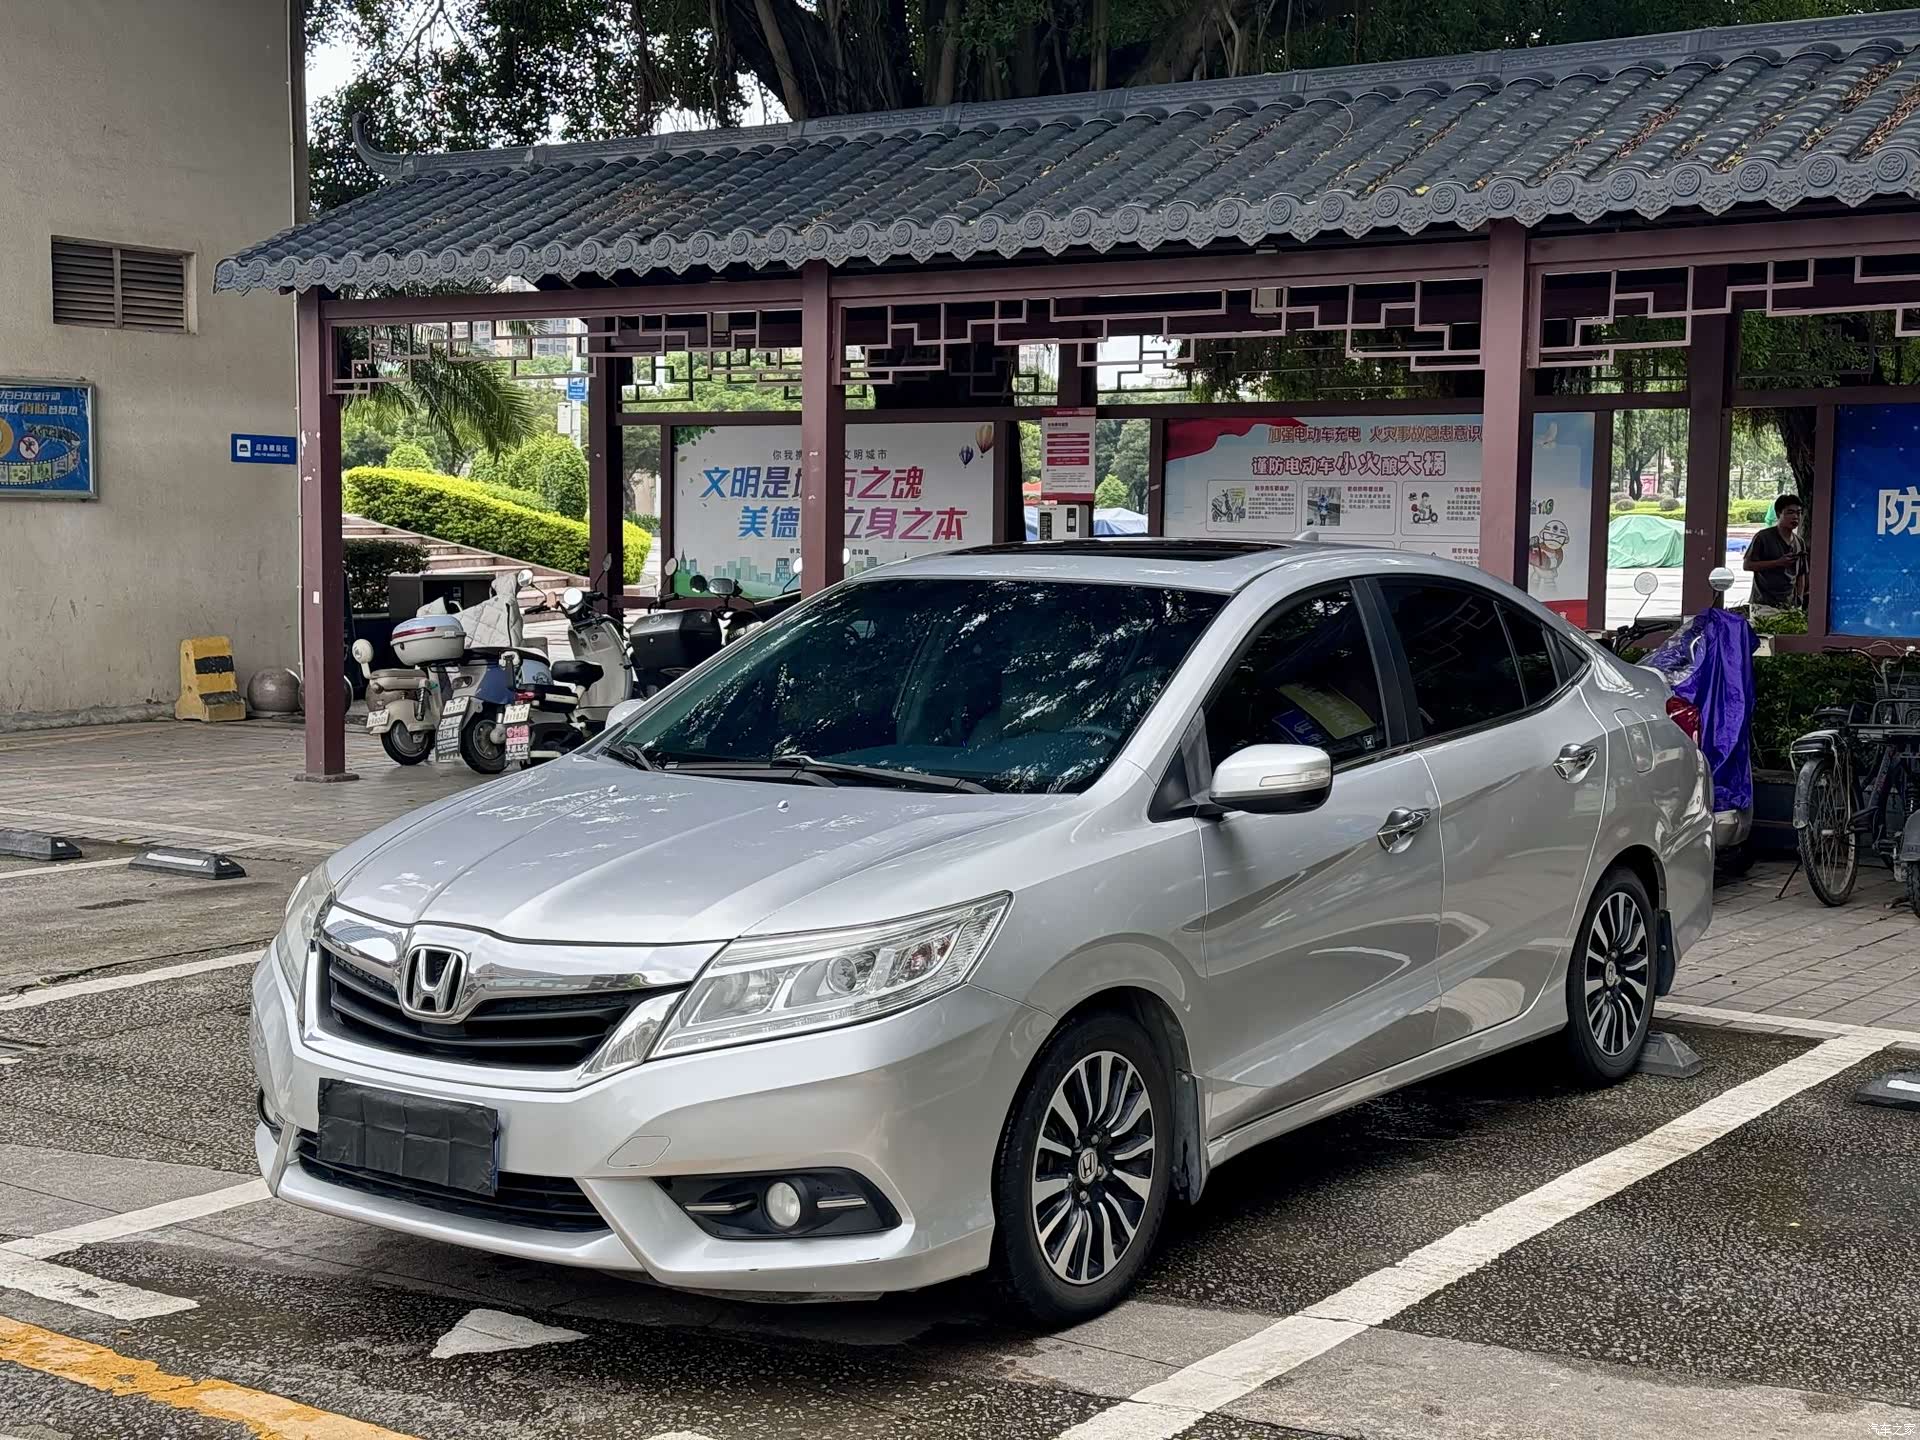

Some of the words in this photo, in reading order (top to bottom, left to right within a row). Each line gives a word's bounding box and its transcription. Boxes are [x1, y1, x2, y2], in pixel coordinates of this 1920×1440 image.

[1269, 427, 1361, 443] 加强电动车充电
[1252, 451, 1446, 476] 谨防电动车小火酿大祸
[737, 505, 968, 541] 美德立身之本
[1876, 486, 1920, 536] 防
